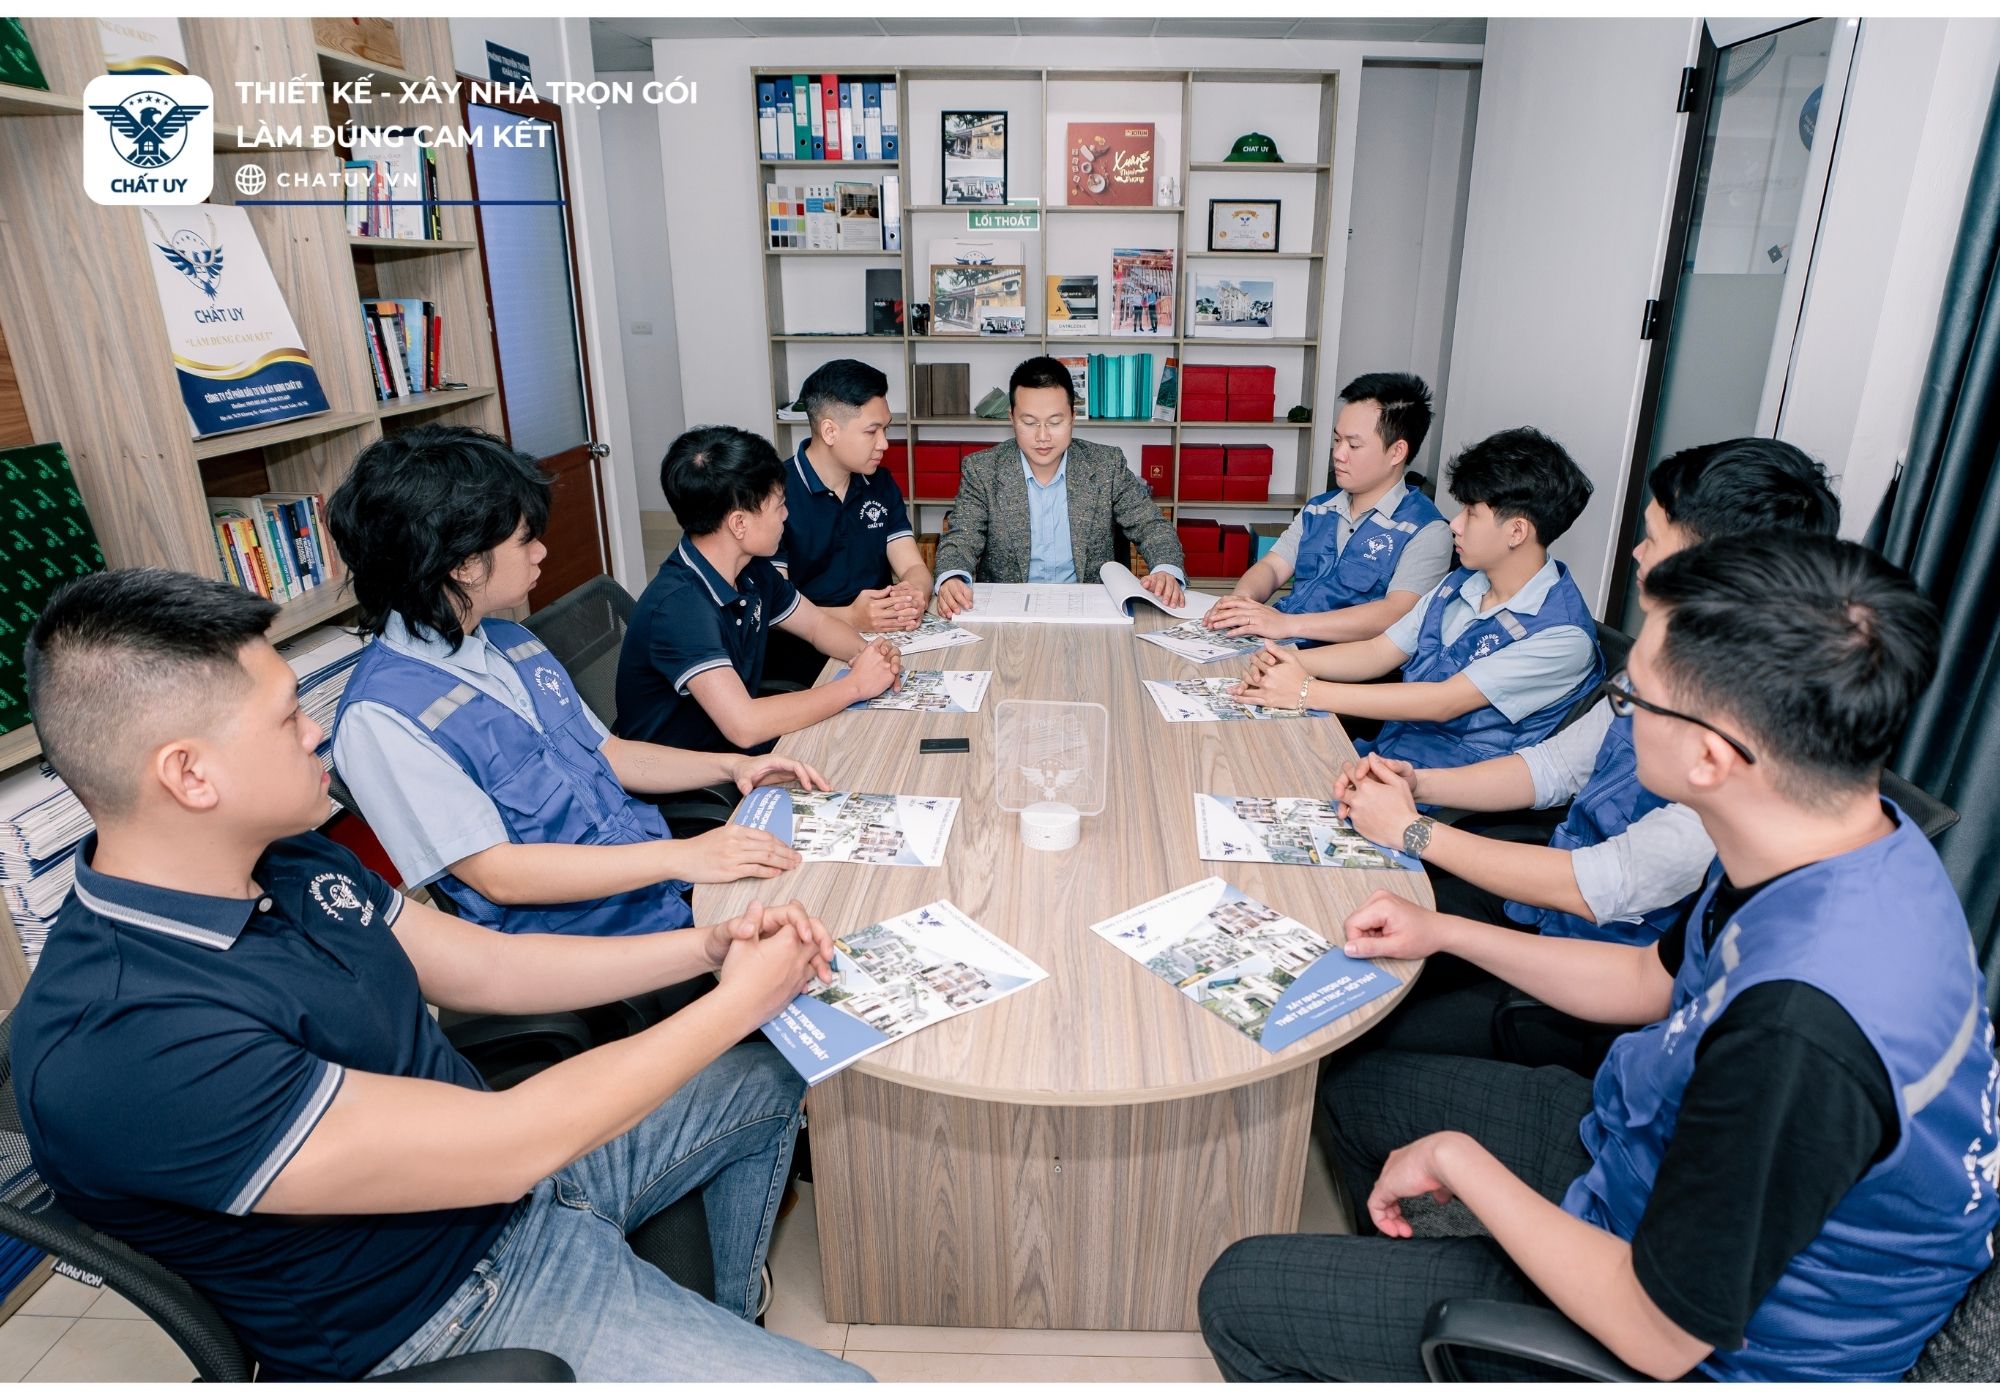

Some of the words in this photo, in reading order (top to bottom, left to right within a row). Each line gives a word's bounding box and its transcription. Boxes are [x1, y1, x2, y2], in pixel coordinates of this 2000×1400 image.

[975, 213, 992, 227] LỐI
[994, 213, 1032, 227] THOÁT
[227, 307, 245, 321] UY
